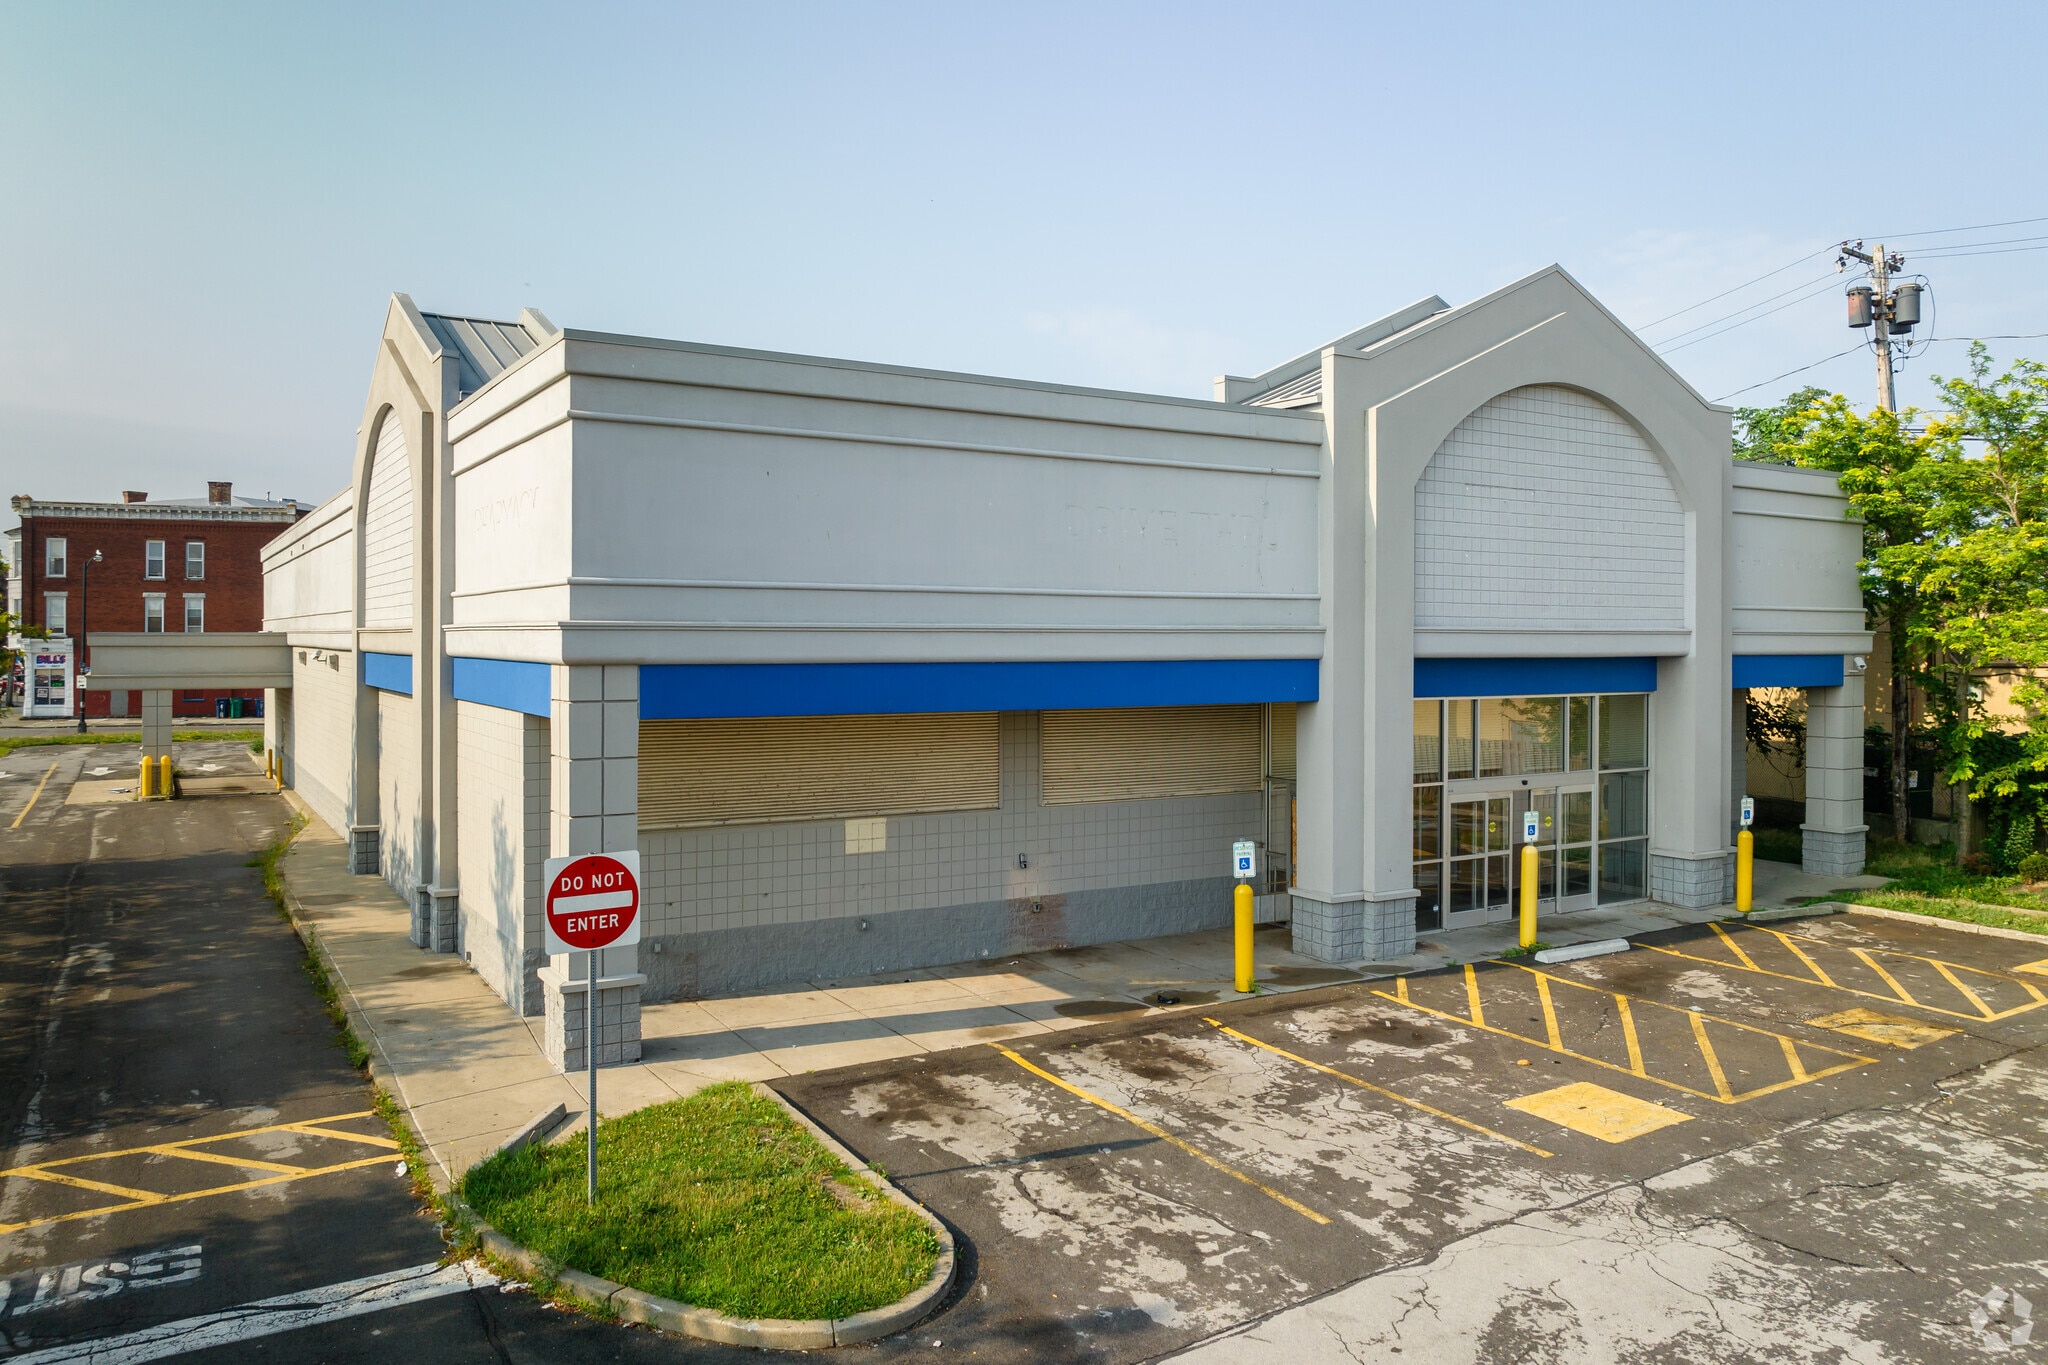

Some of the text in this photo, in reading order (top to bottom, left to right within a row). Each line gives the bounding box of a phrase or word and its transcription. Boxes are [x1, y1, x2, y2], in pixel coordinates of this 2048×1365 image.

[36, 654, 66, 664] BILL'S
[561, 871, 625, 892] DO NOT
[567, 913, 619, 933] ENTER
